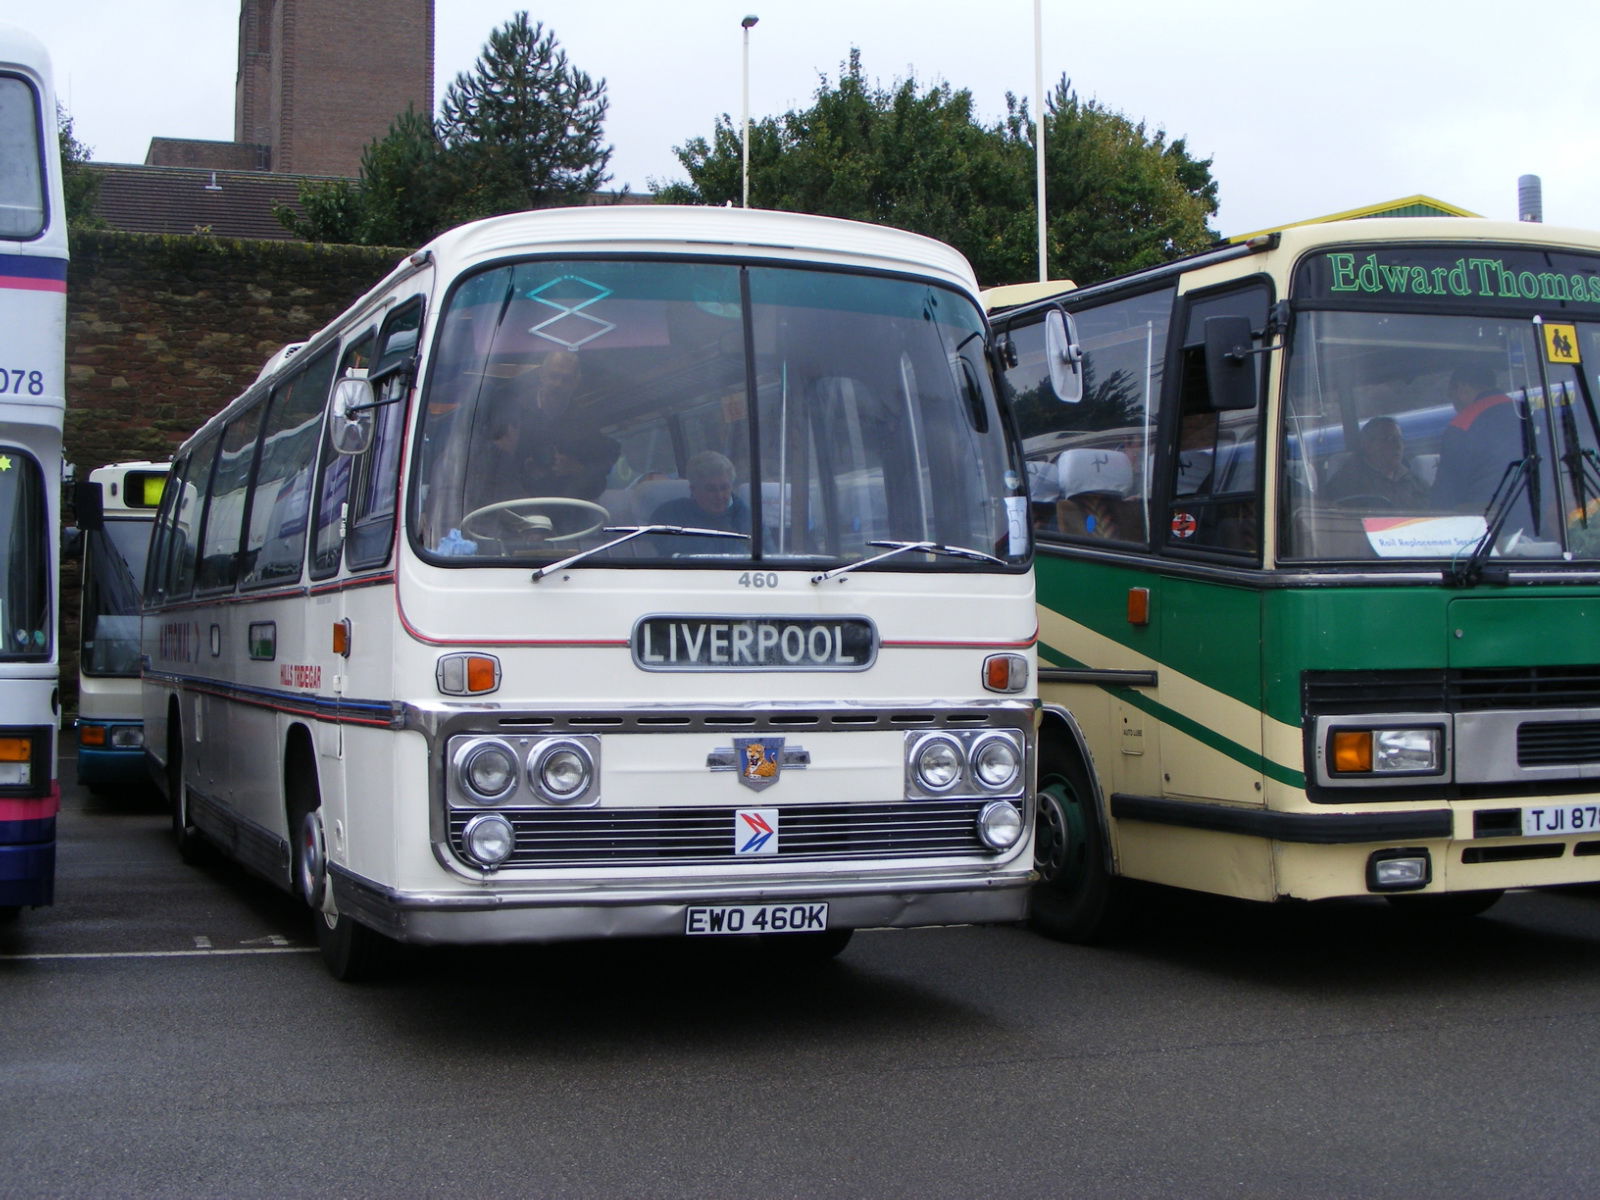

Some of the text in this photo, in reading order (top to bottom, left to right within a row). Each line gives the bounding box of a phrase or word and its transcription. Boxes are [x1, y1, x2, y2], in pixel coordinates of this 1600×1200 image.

[1327, 253, 1600, 304] Edward Thomas
[1398, 537, 1452, 548] Replacement
[738, 572, 779, 588] 460
[643, 623, 855, 664] LIVERPOOL
[1532, 806, 1600, 831] TJI 87
[688, 905, 826, 933] EWO 460K
